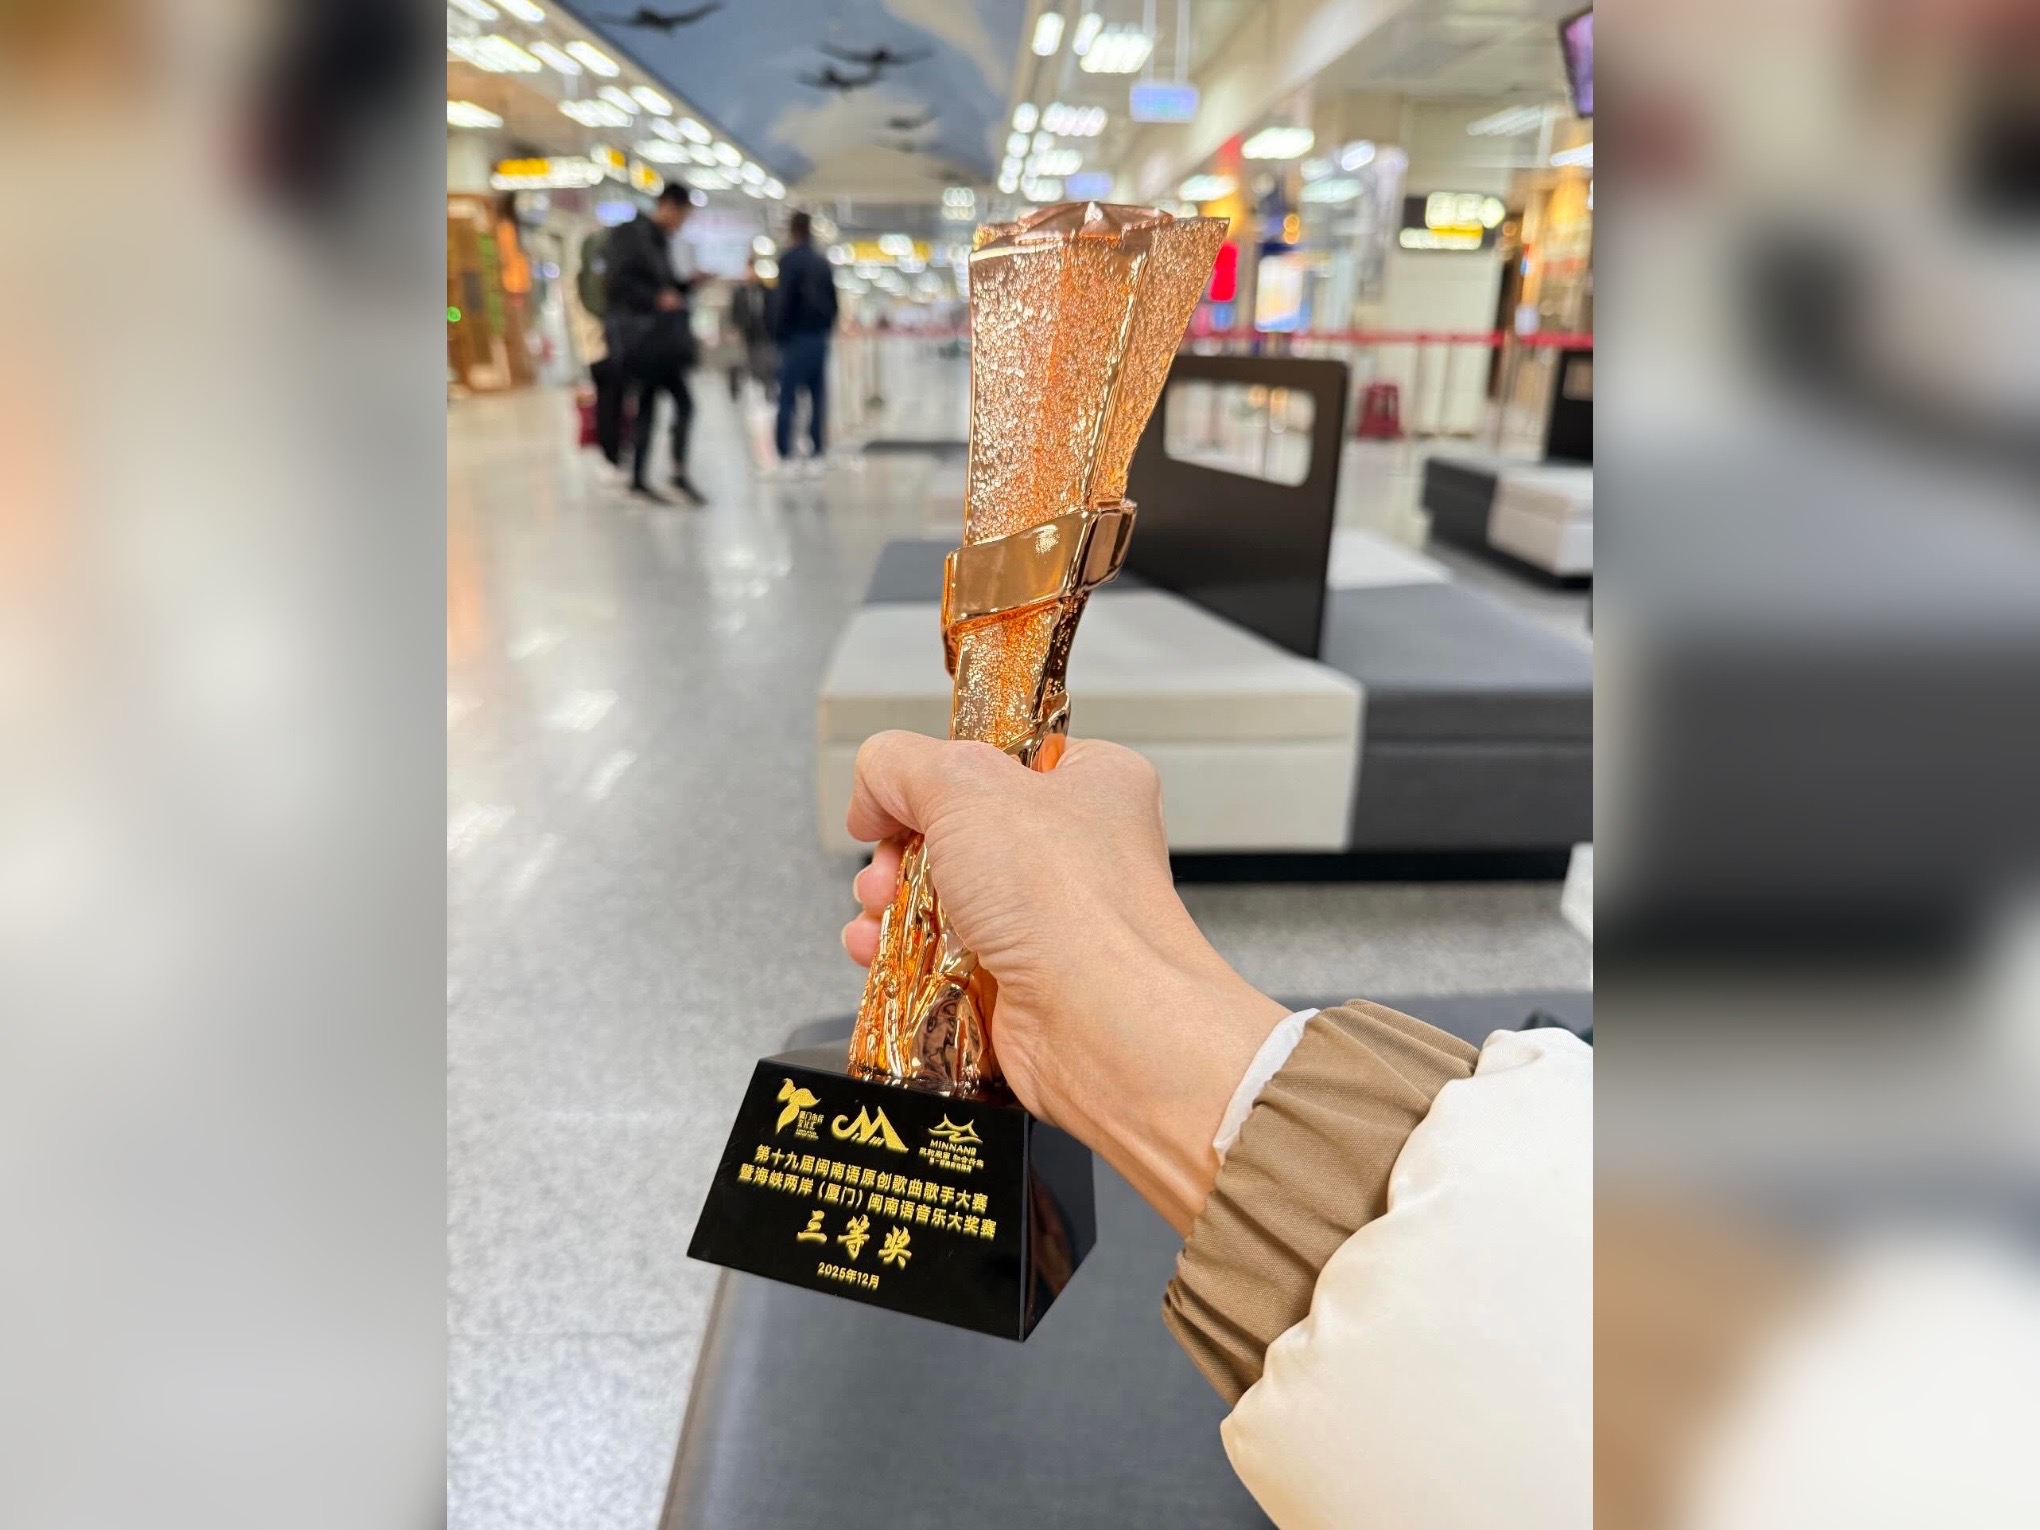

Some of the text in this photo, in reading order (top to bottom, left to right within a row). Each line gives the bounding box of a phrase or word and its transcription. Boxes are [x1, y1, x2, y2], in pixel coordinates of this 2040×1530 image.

[754, 1143, 989, 1215] 第十九届闽南语原创歌曲歌手大赛
[796, 1210, 912, 1269] 三等奖
[816, 1262, 880, 1290] 2025年12月
